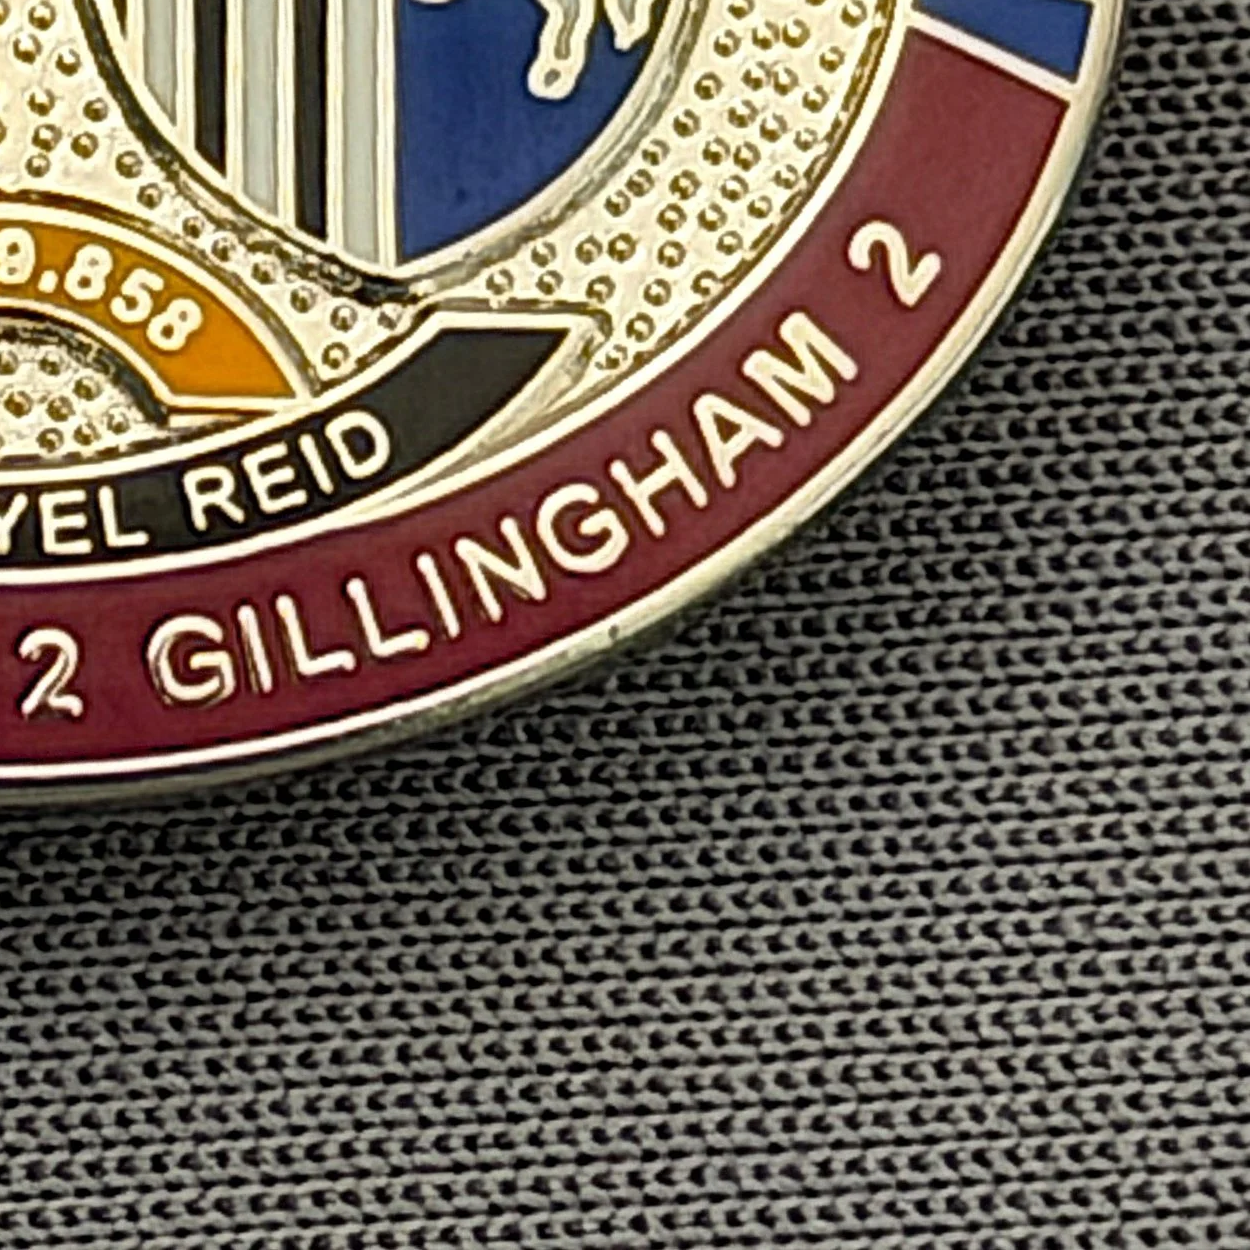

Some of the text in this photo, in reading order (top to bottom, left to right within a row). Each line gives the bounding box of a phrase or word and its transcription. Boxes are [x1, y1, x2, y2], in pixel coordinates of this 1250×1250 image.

[18, 628, 84, 720] 2
[147, 310, 860, 708] GILLINGHAM
[848, 220, 943, 307] 2
[183, 411, 392, 533] REID
